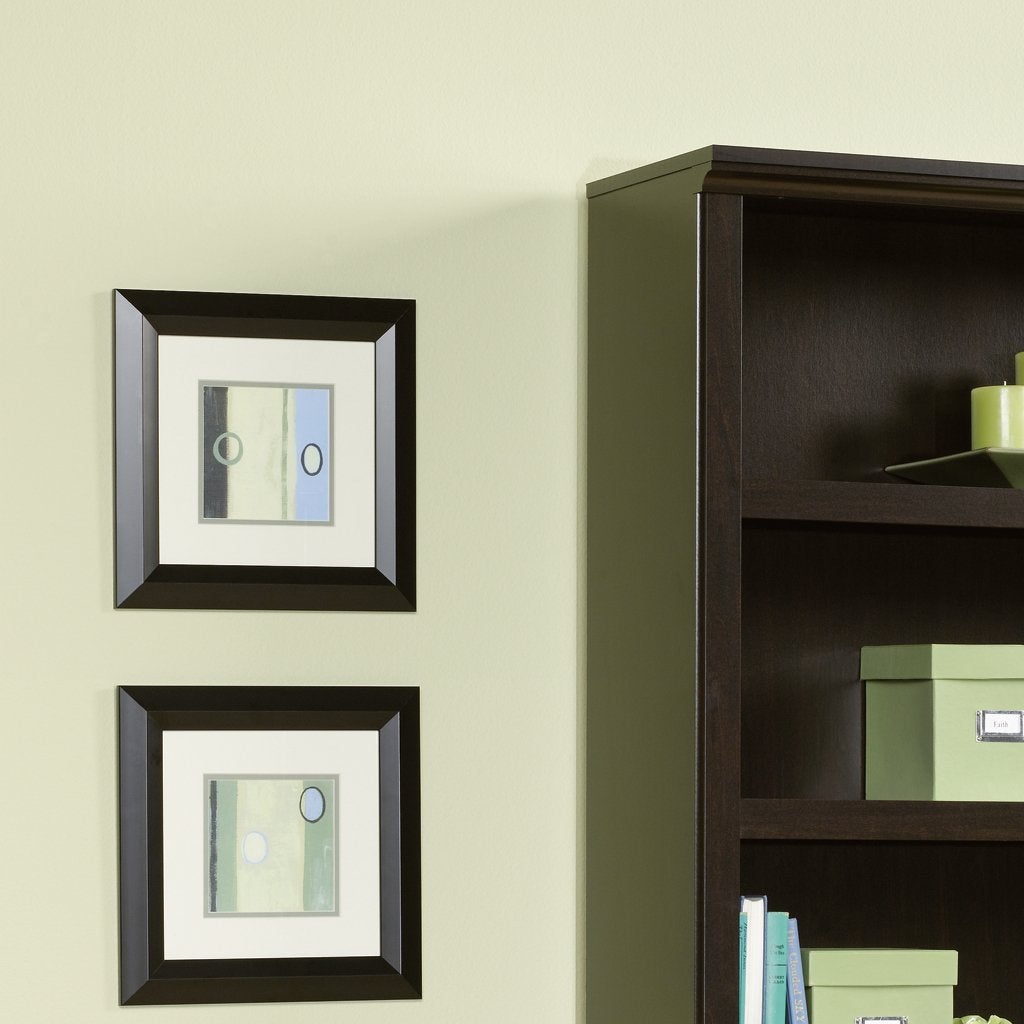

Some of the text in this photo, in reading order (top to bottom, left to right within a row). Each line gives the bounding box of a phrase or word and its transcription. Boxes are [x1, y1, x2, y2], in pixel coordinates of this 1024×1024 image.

[993, 720, 1009, 728] Faith
[789, 952, 802, 995] Clouded
[794, 999, 806, 1023] SKY
